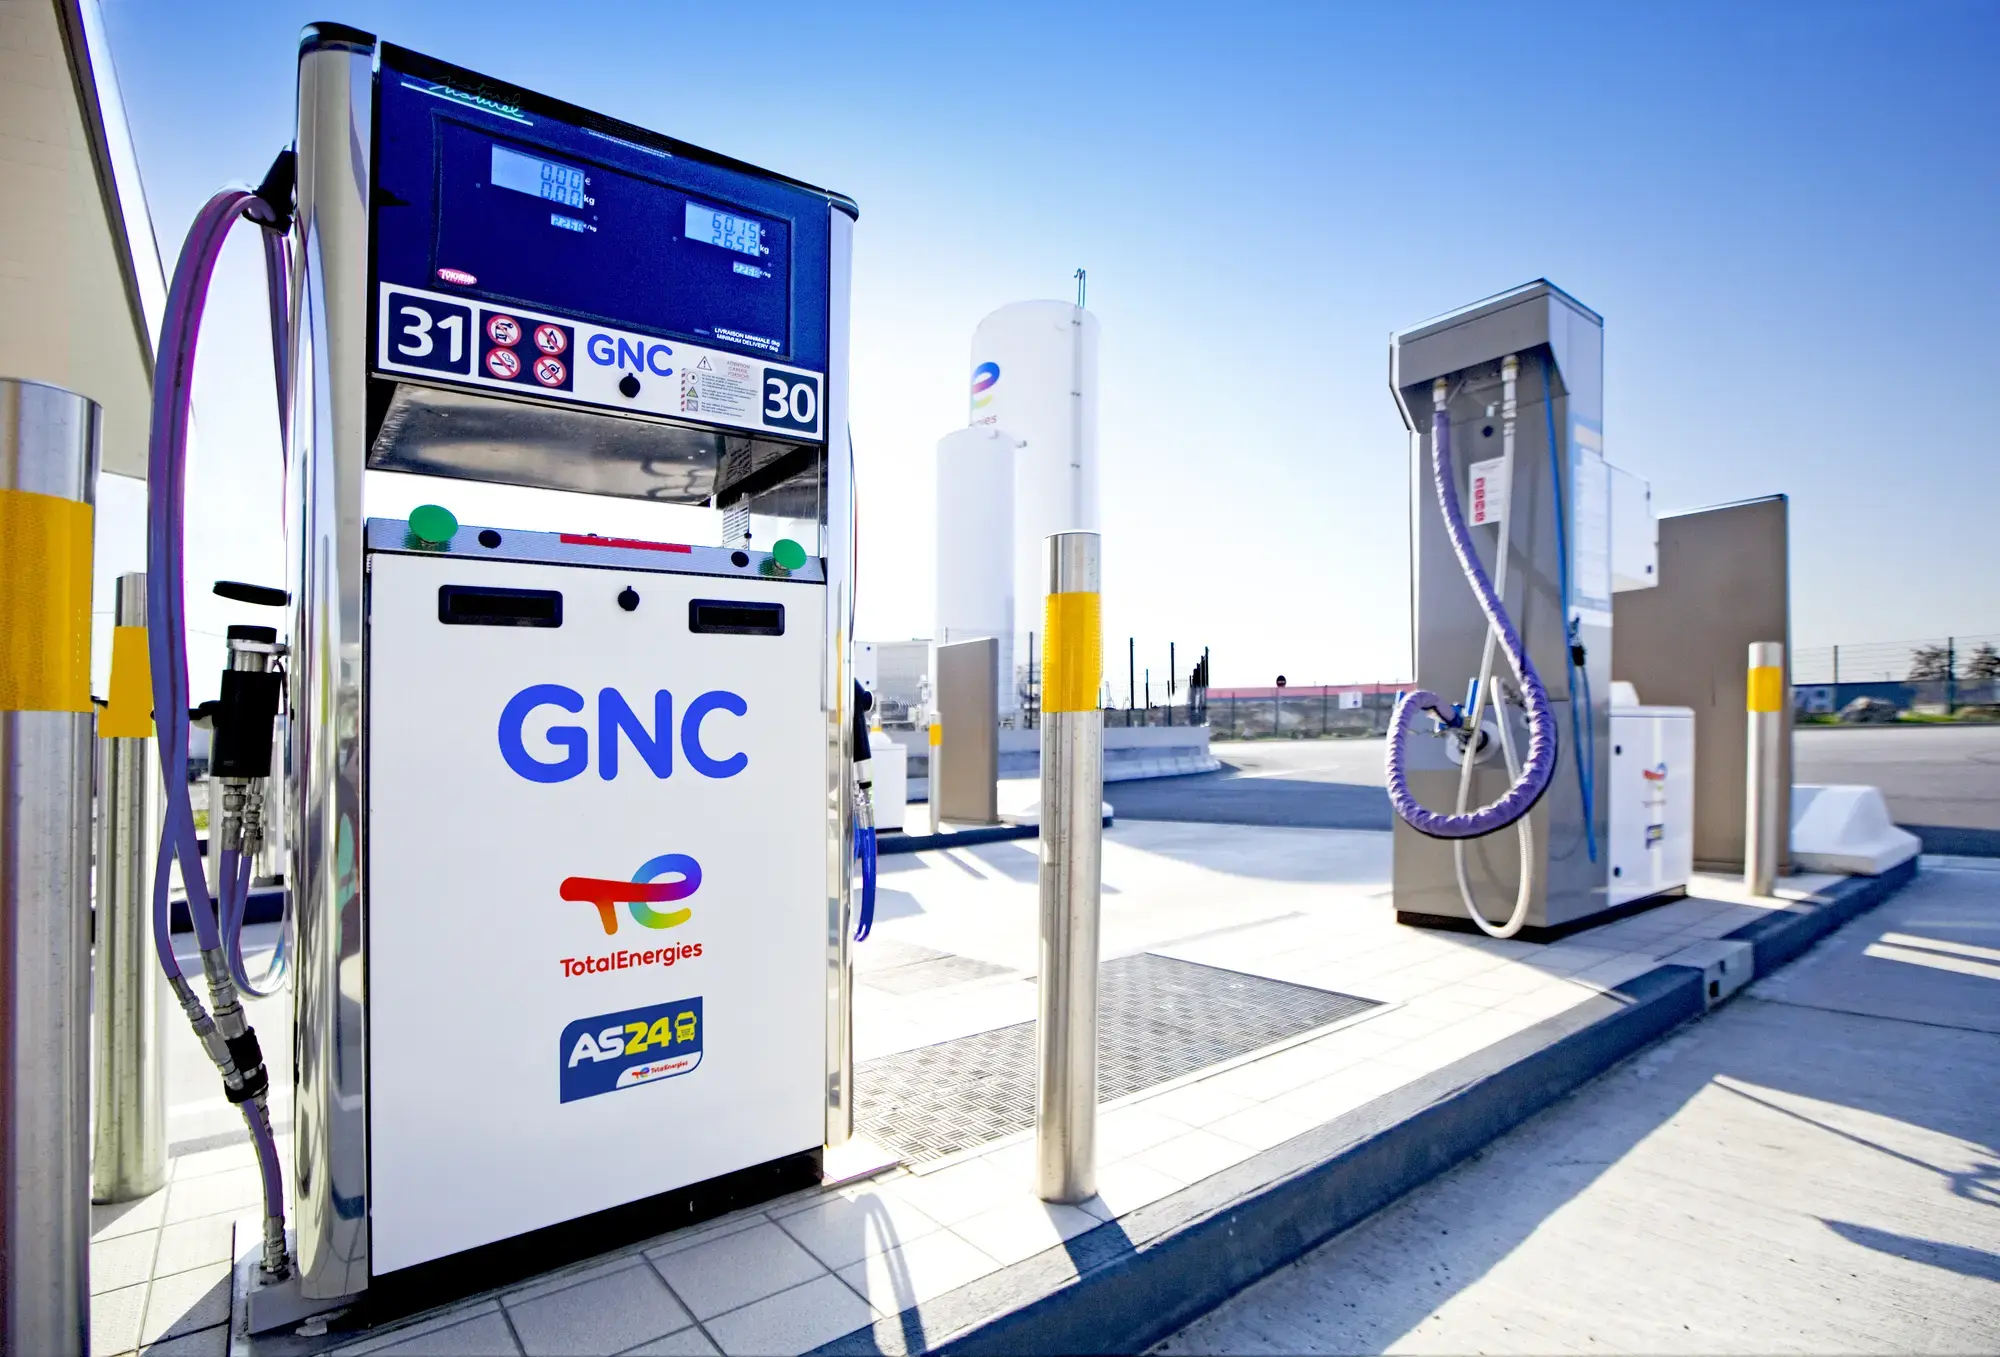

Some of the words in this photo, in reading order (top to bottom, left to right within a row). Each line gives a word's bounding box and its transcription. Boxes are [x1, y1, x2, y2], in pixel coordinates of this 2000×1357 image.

[584, 194, 595, 206] kg
[760, 244, 770, 255] kg
[397, 306, 464, 363] 31
[714, 327, 744, 338] LIVRAISON
[716, 333, 742, 344] MINIMUM
[742, 339, 768, 349] DELIVERY
[586, 333, 674, 377] GNC
[764, 377, 816, 424] 30
[498, 684, 748, 783] GNC
[560, 942, 703, 977] TotalEnergies
[568, 1016, 672, 1068] AS24
